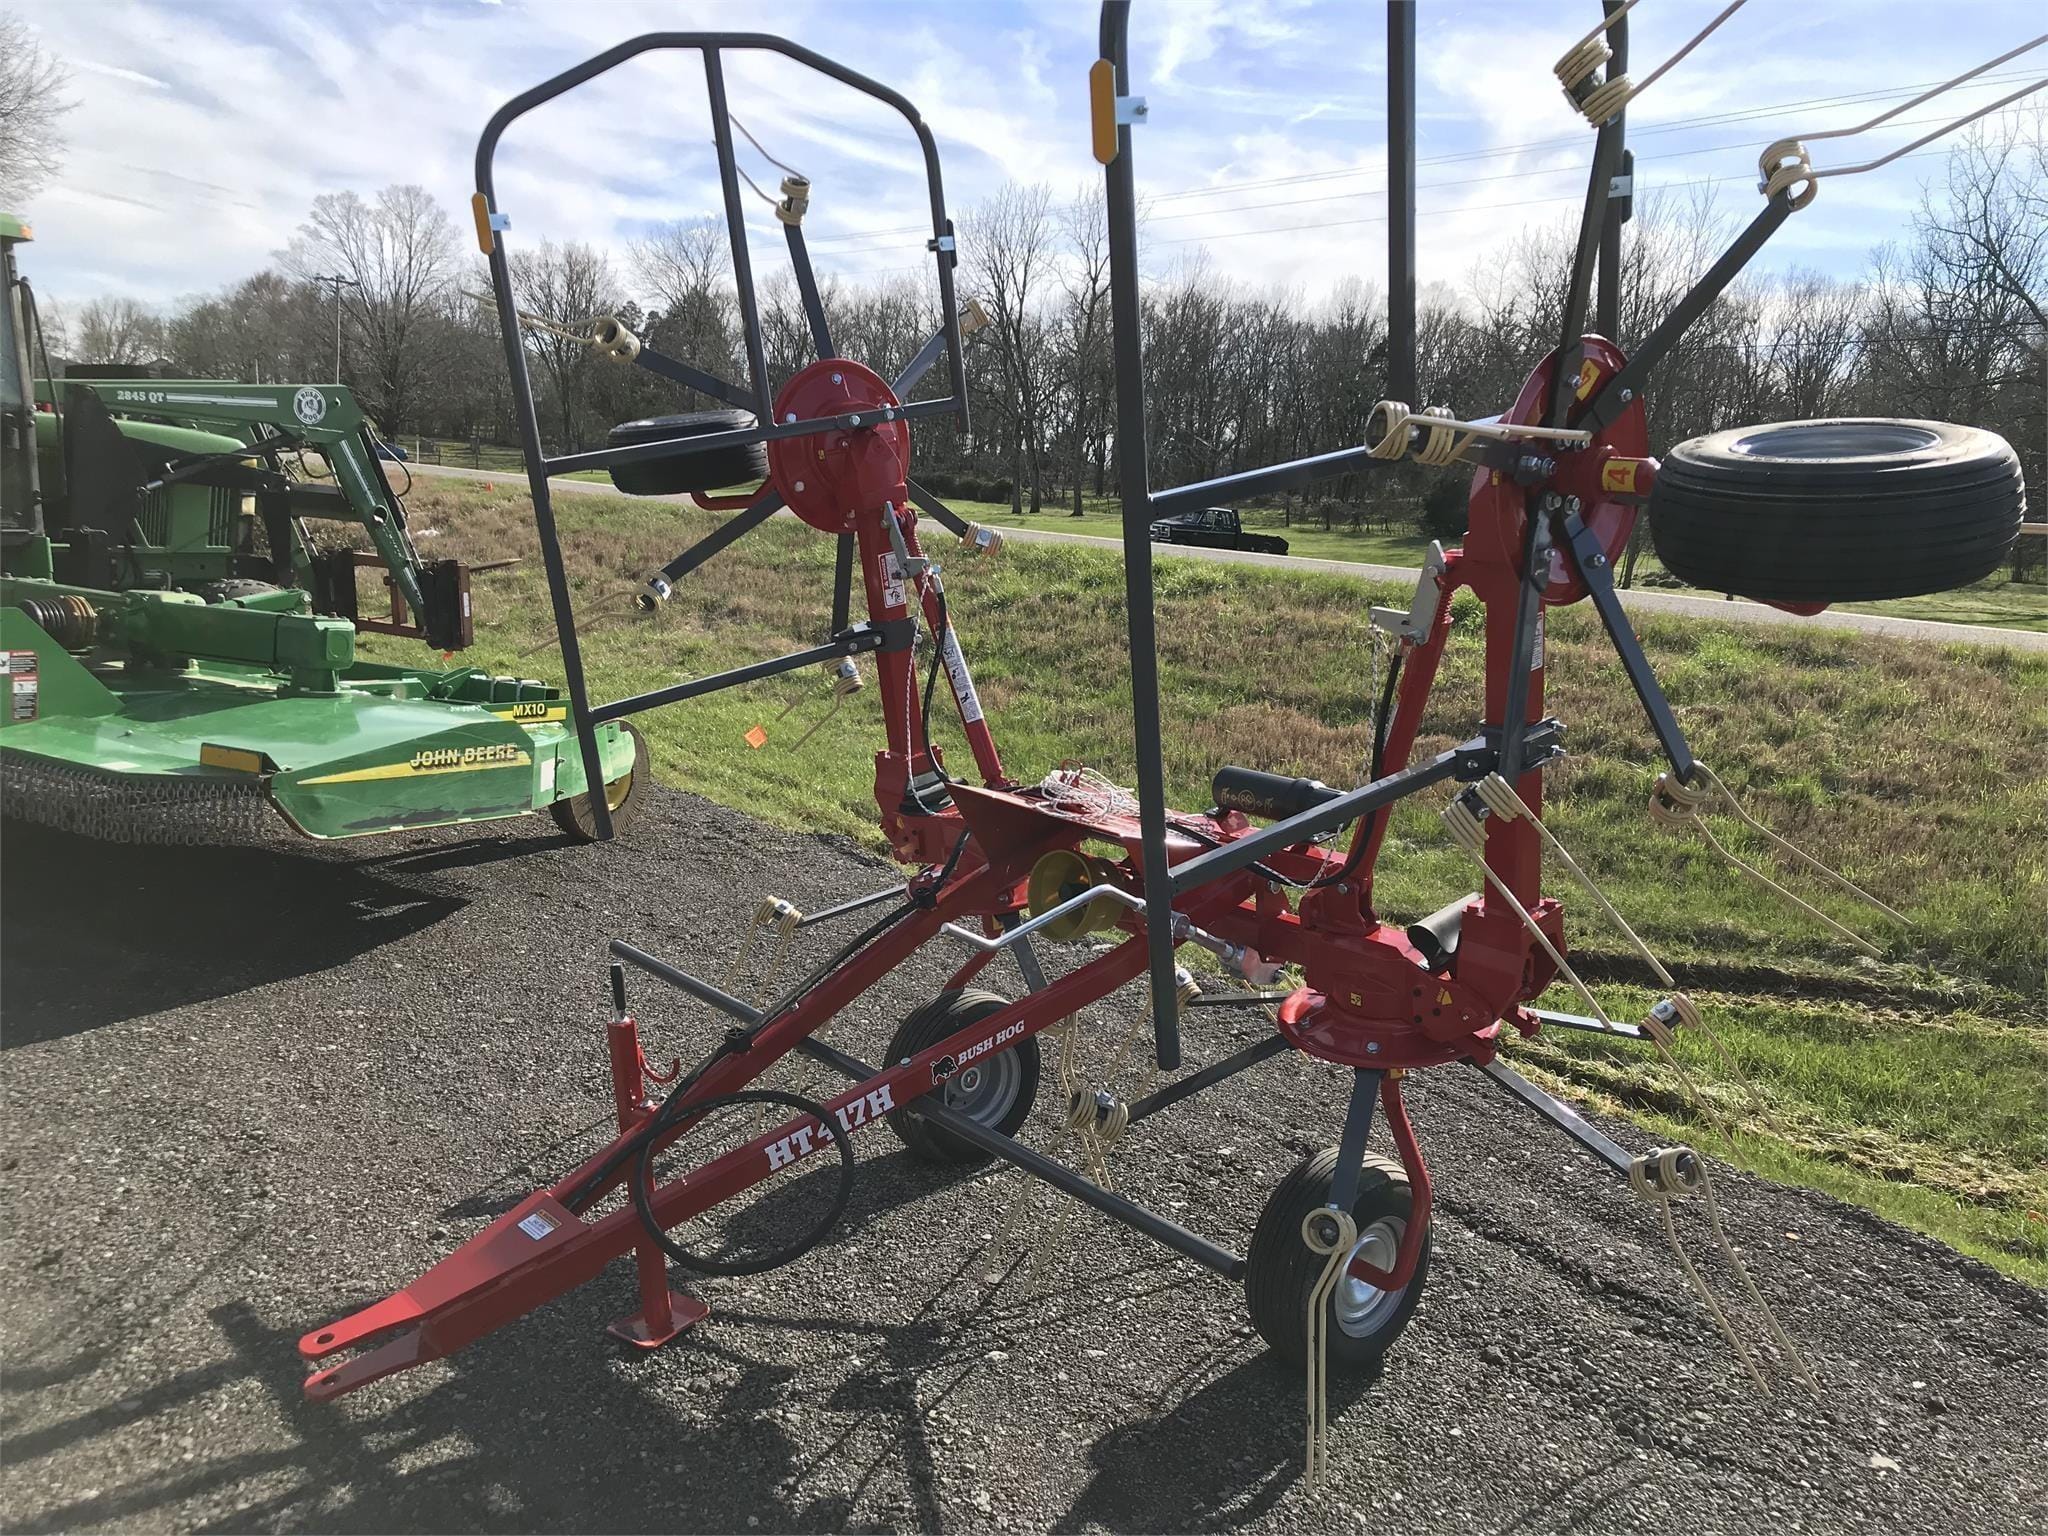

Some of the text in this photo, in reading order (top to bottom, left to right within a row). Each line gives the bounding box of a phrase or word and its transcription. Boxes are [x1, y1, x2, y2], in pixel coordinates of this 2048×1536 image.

[117, 390, 165, 404] 2845 QT
[302, 412, 318, 421] HOG
[512, 703, 546, 717] MX10
[410, 742, 518, 768] JOHN DEERE
[958, 1020, 1026, 1066] BUSH HOG
